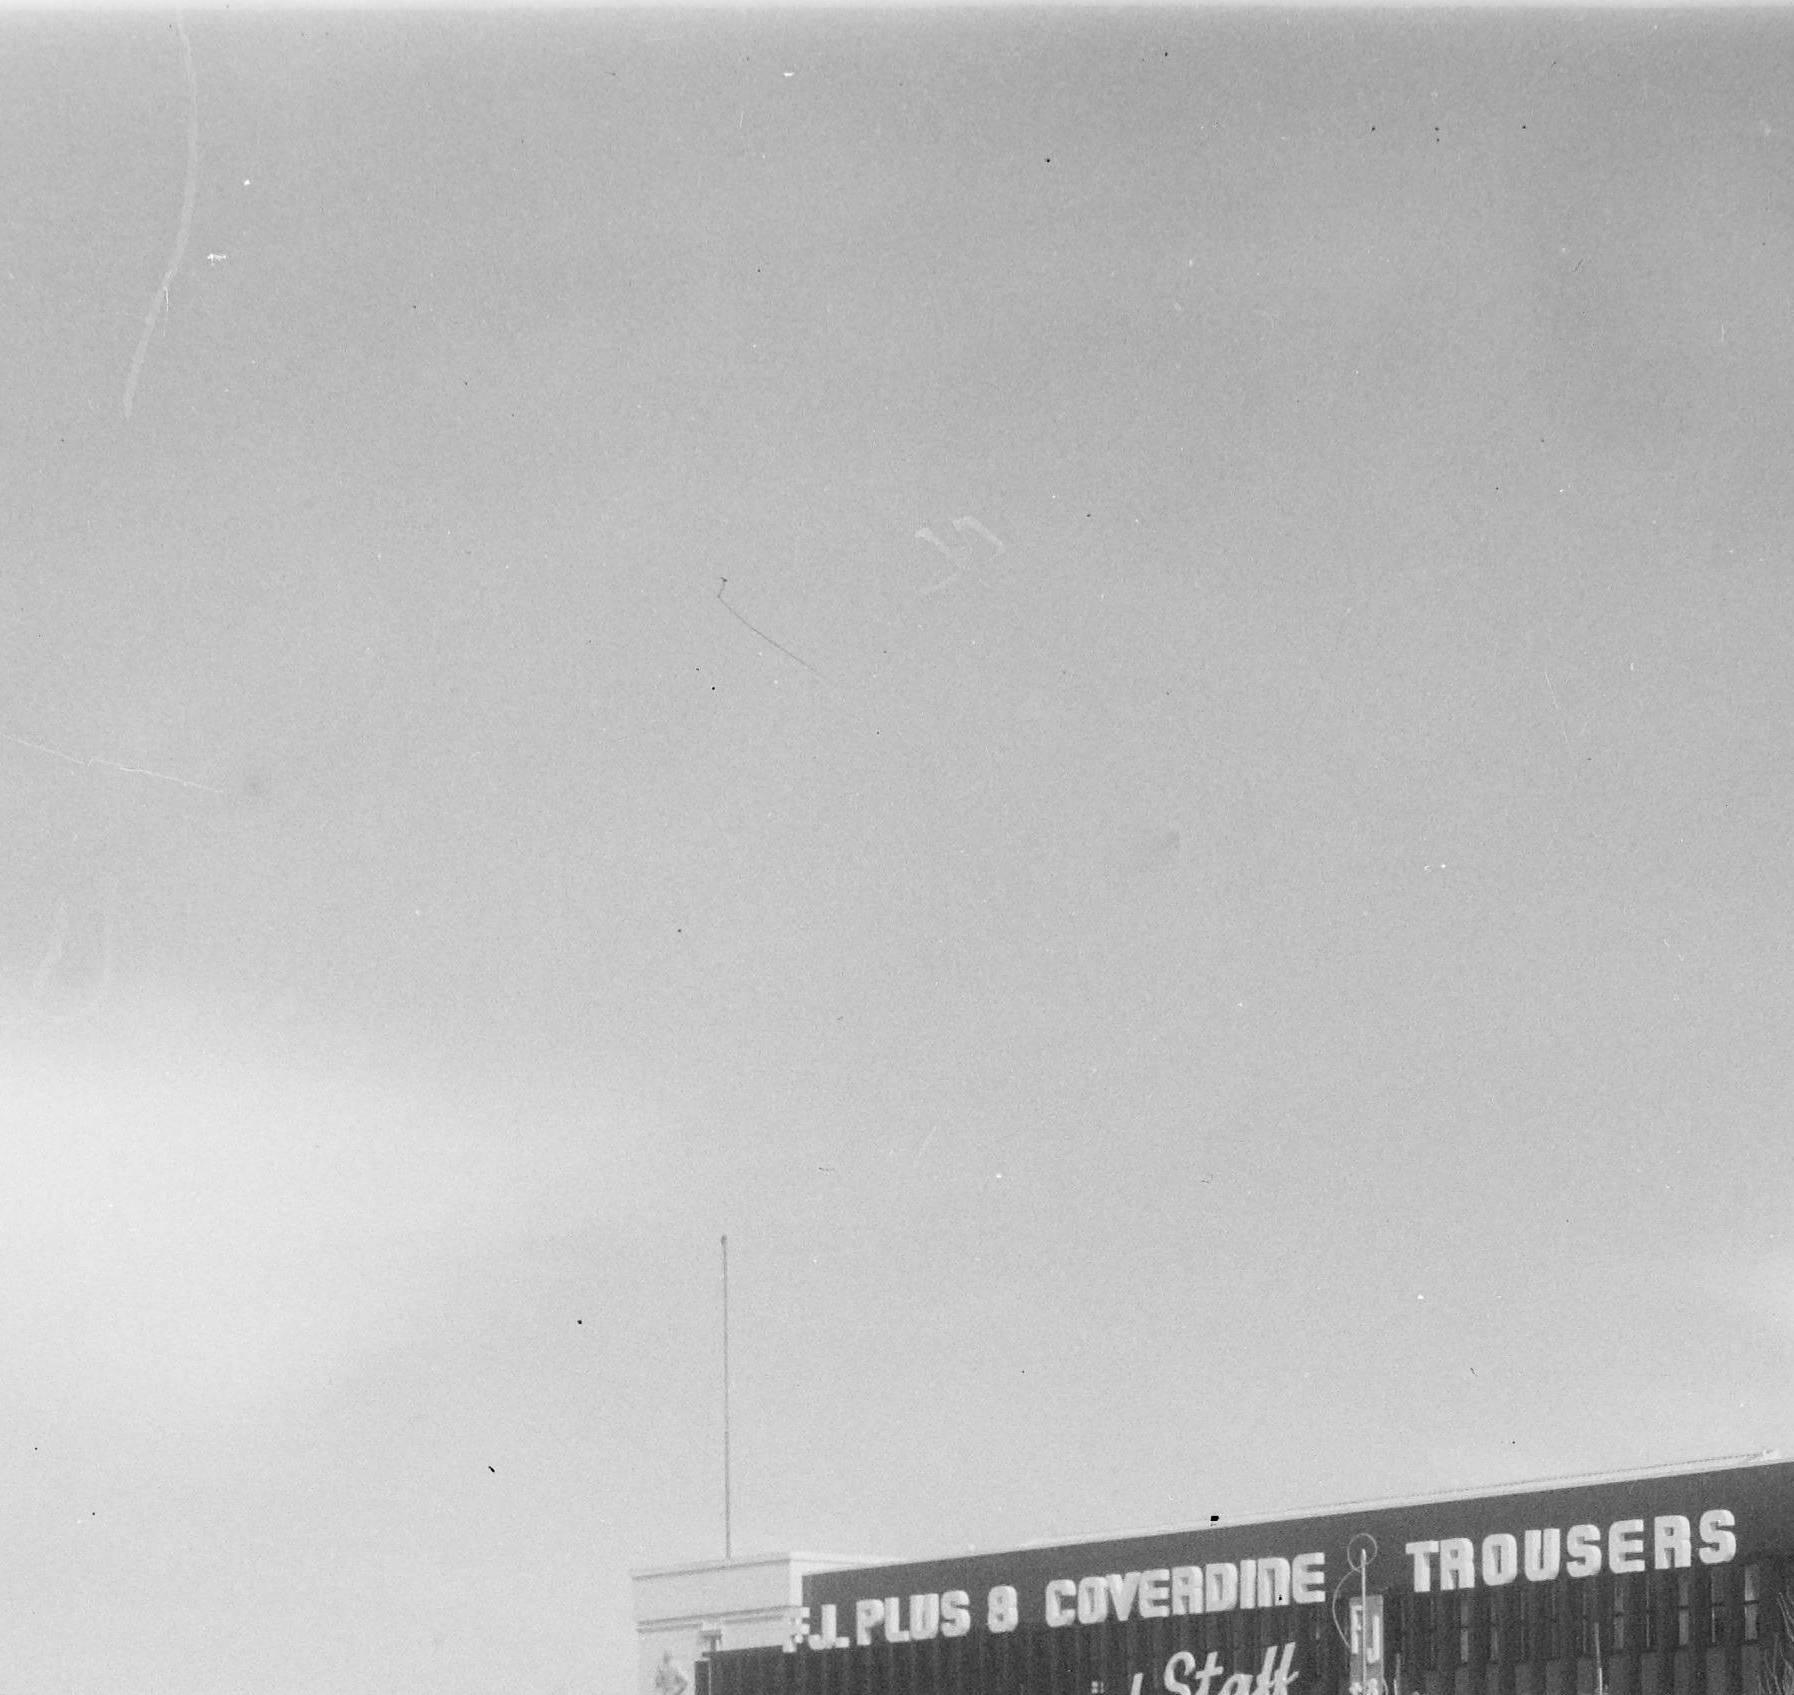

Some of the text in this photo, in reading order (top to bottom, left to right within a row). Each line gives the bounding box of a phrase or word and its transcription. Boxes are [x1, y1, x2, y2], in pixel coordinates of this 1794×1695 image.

[856, 1589, 970, 1646] PLUS
[988, 1585, 1018, 1633] 8
[1044, 1551, 1325, 1628] COVERDINE
[1406, 1508, 1737, 1593] TROUSERS
